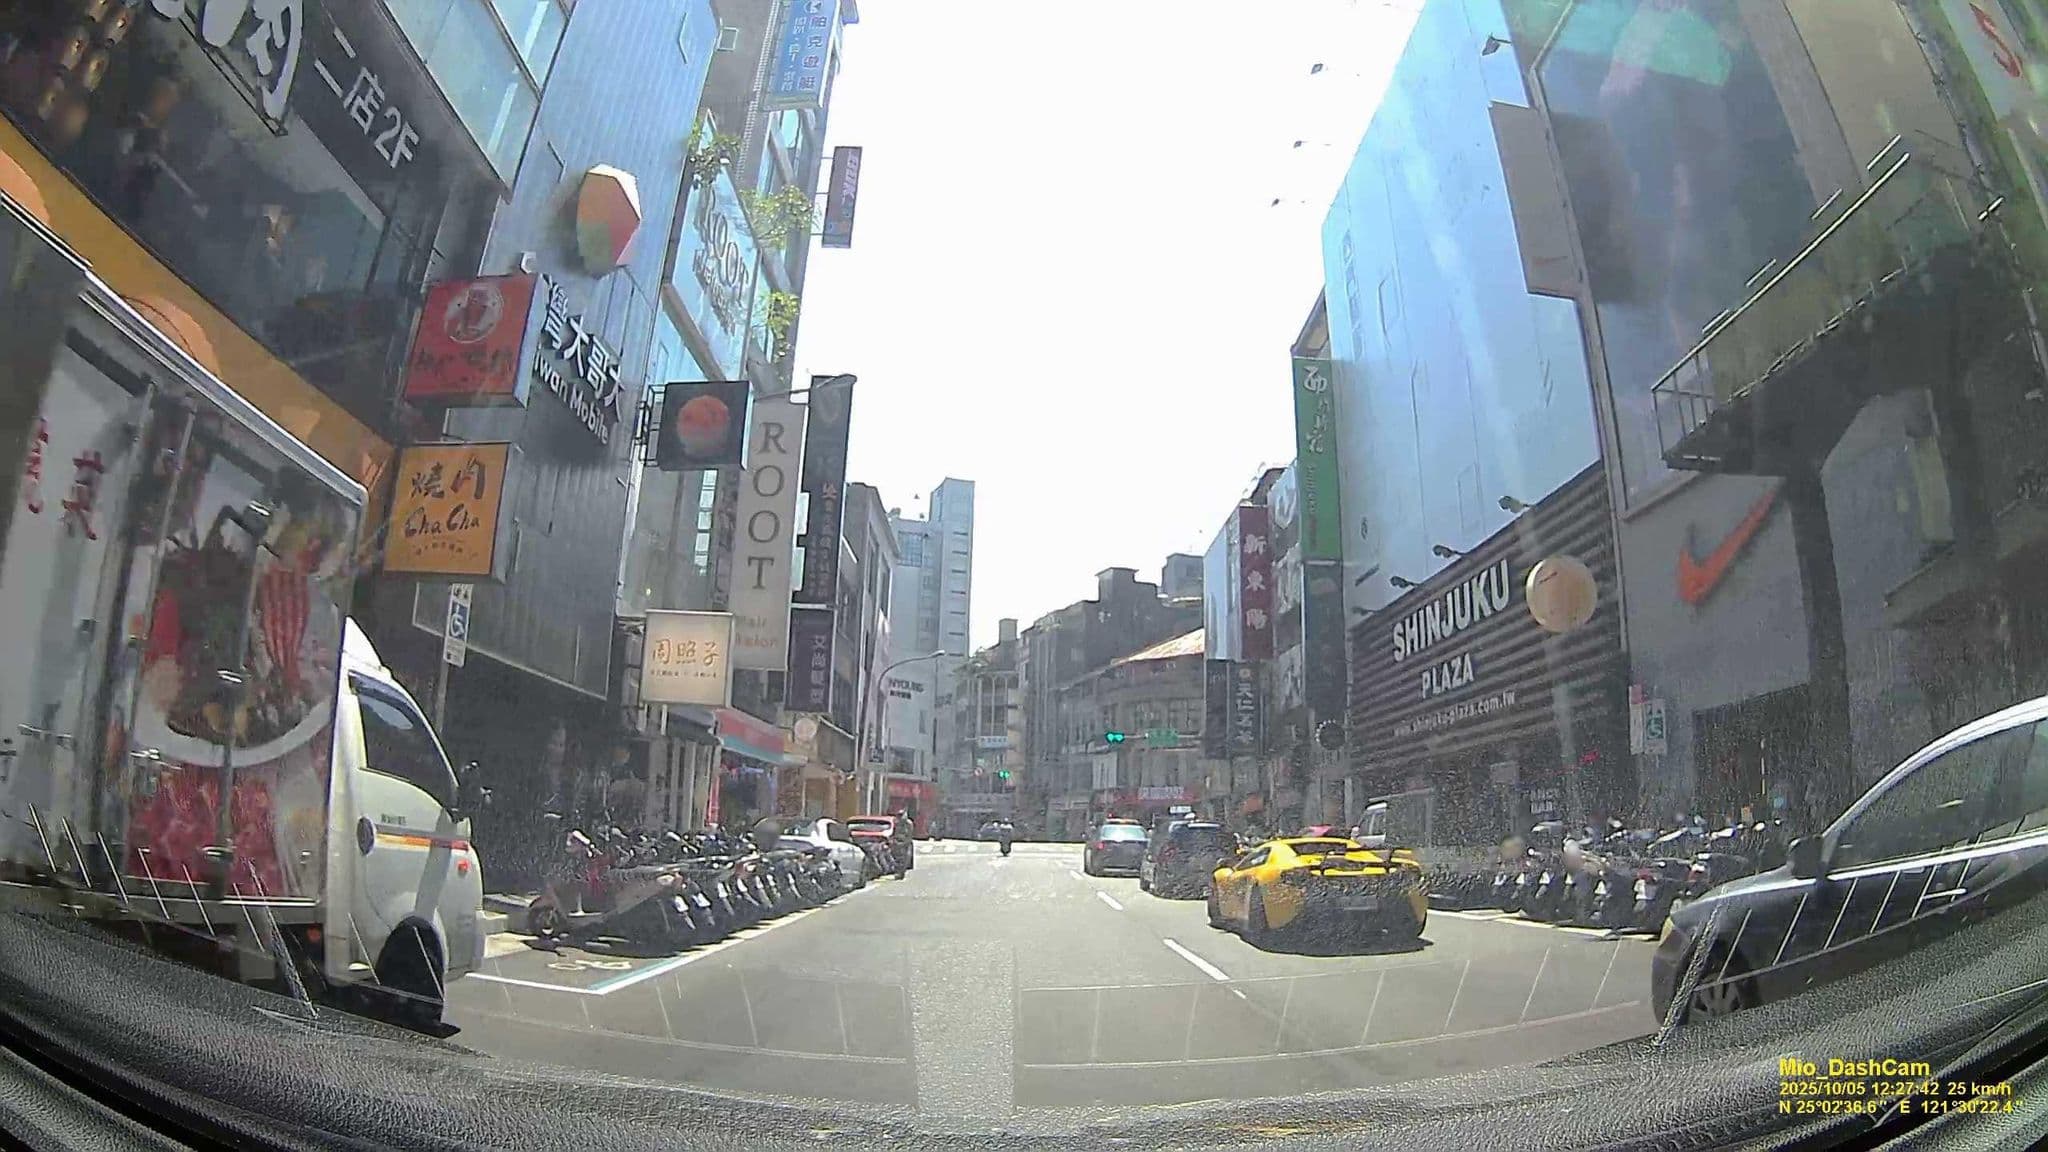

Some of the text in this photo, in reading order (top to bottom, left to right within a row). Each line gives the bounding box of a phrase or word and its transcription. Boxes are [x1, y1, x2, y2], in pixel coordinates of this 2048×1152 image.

[569, 383, 609, 444] Mobile
[748, 421, 787, 590] ROOT
[1393, 559, 1510, 662] SHINJUKU
[1422, 652, 1474, 699] PLAZA
